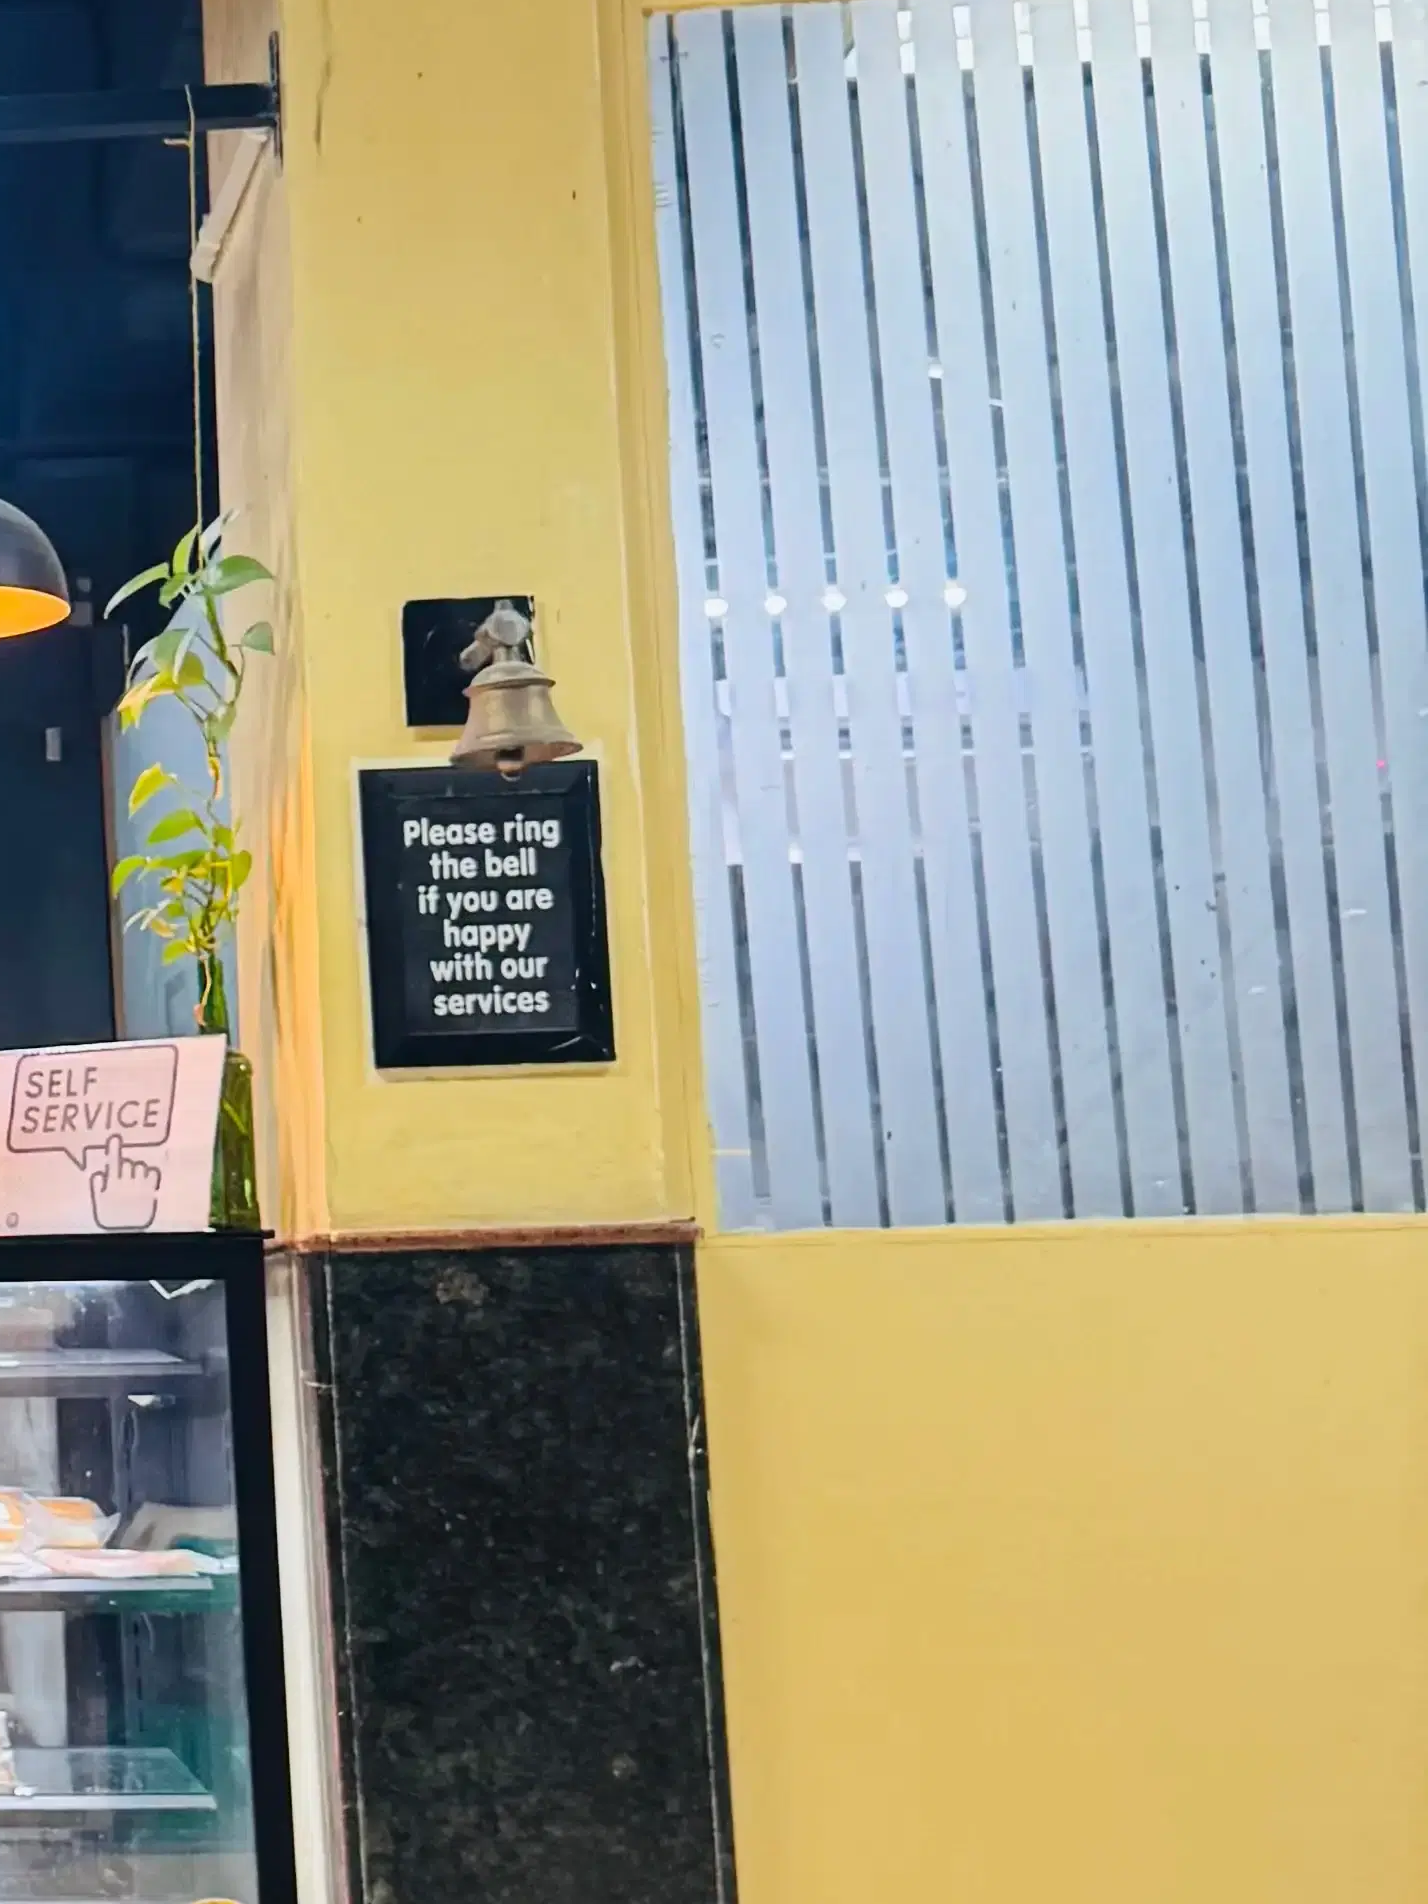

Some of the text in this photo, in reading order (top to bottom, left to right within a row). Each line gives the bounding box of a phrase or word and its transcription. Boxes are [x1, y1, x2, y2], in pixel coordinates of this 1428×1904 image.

[402, 813, 560, 848] Please ring
[429, 847, 537, 881] the bell
[417, 885, 554, 920] if you are
[443, 920, 532, 952] happy
[430, 953, 549, 982] with our
[434, 985, 550, 1016] services
[25, 1067, 98, 1099] SELF
[21, 1099, 160, 1133] SERVICE
